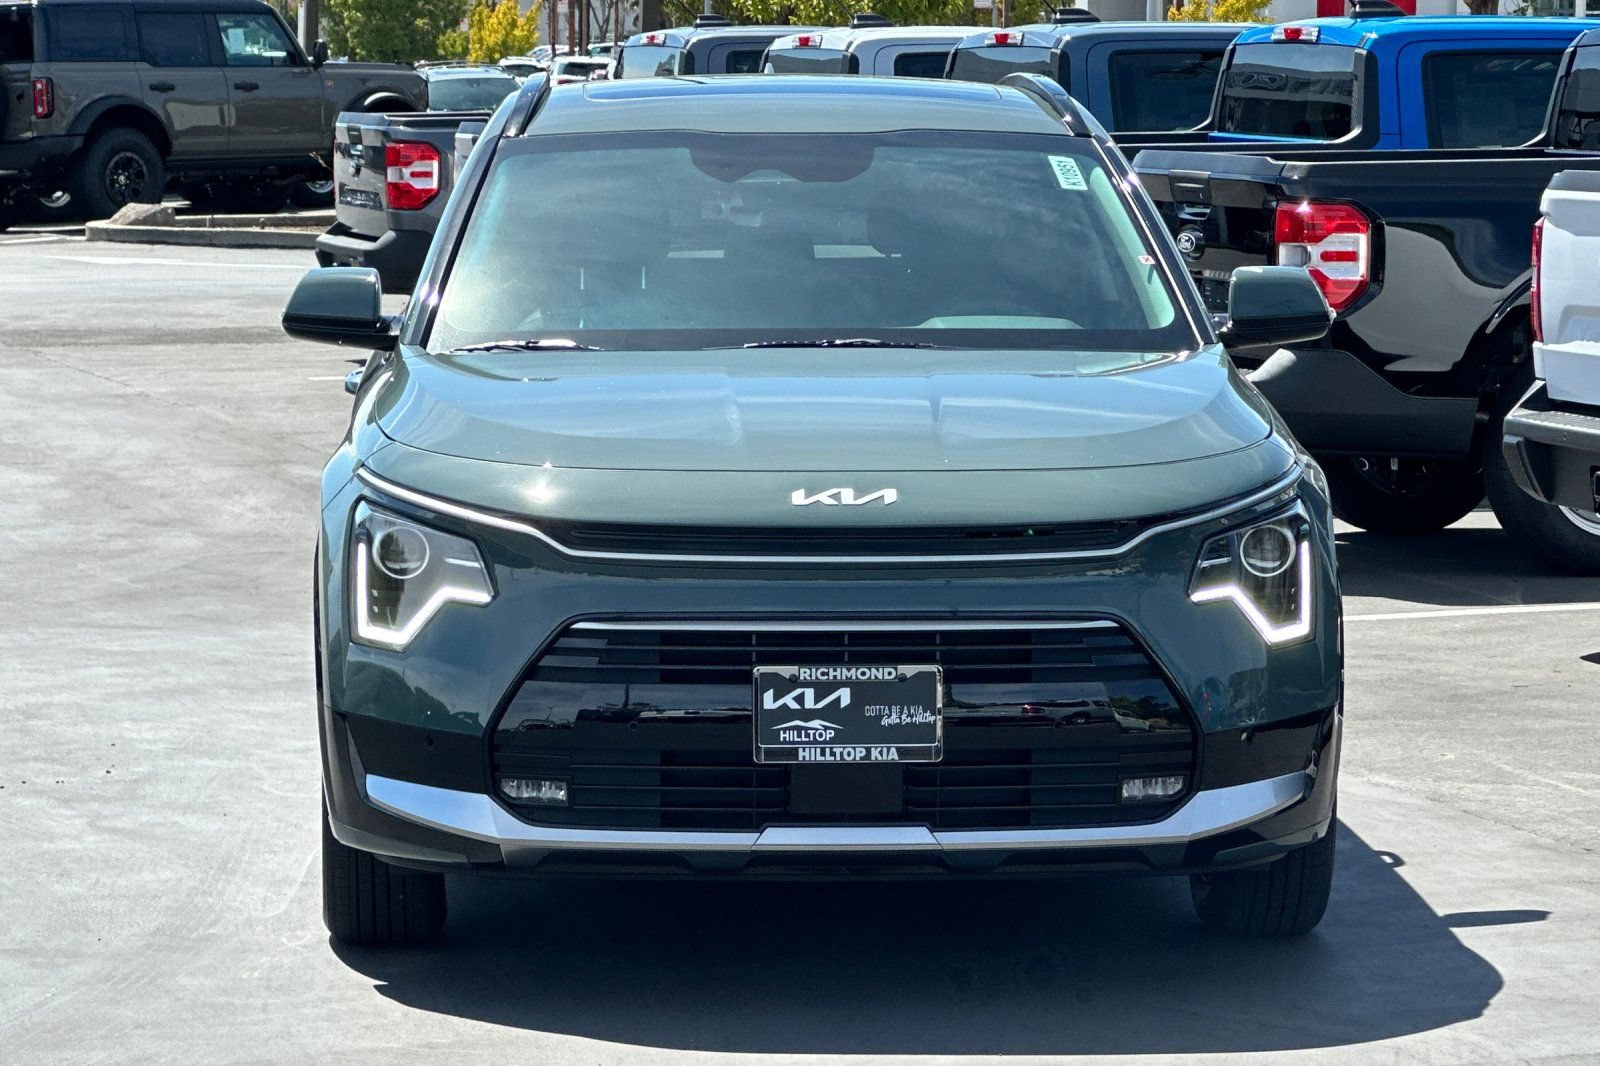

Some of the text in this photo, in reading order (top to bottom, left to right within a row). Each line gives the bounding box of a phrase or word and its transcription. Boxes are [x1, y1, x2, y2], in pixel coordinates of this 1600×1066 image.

[792, 488, 897, 505] KIA
[799, 667, 897, 680] RICHMOND
[763, 687, 851, 710] KIA
[864, 705, 923, 716] GOTTA BE A KIA
[881, 713, 901, 726] Gotta
[901, 714, 912, 725] Be
[779, 730, 835, 742] HILLTOP
[798, 747, 899, 761] HILLTOP KIA
